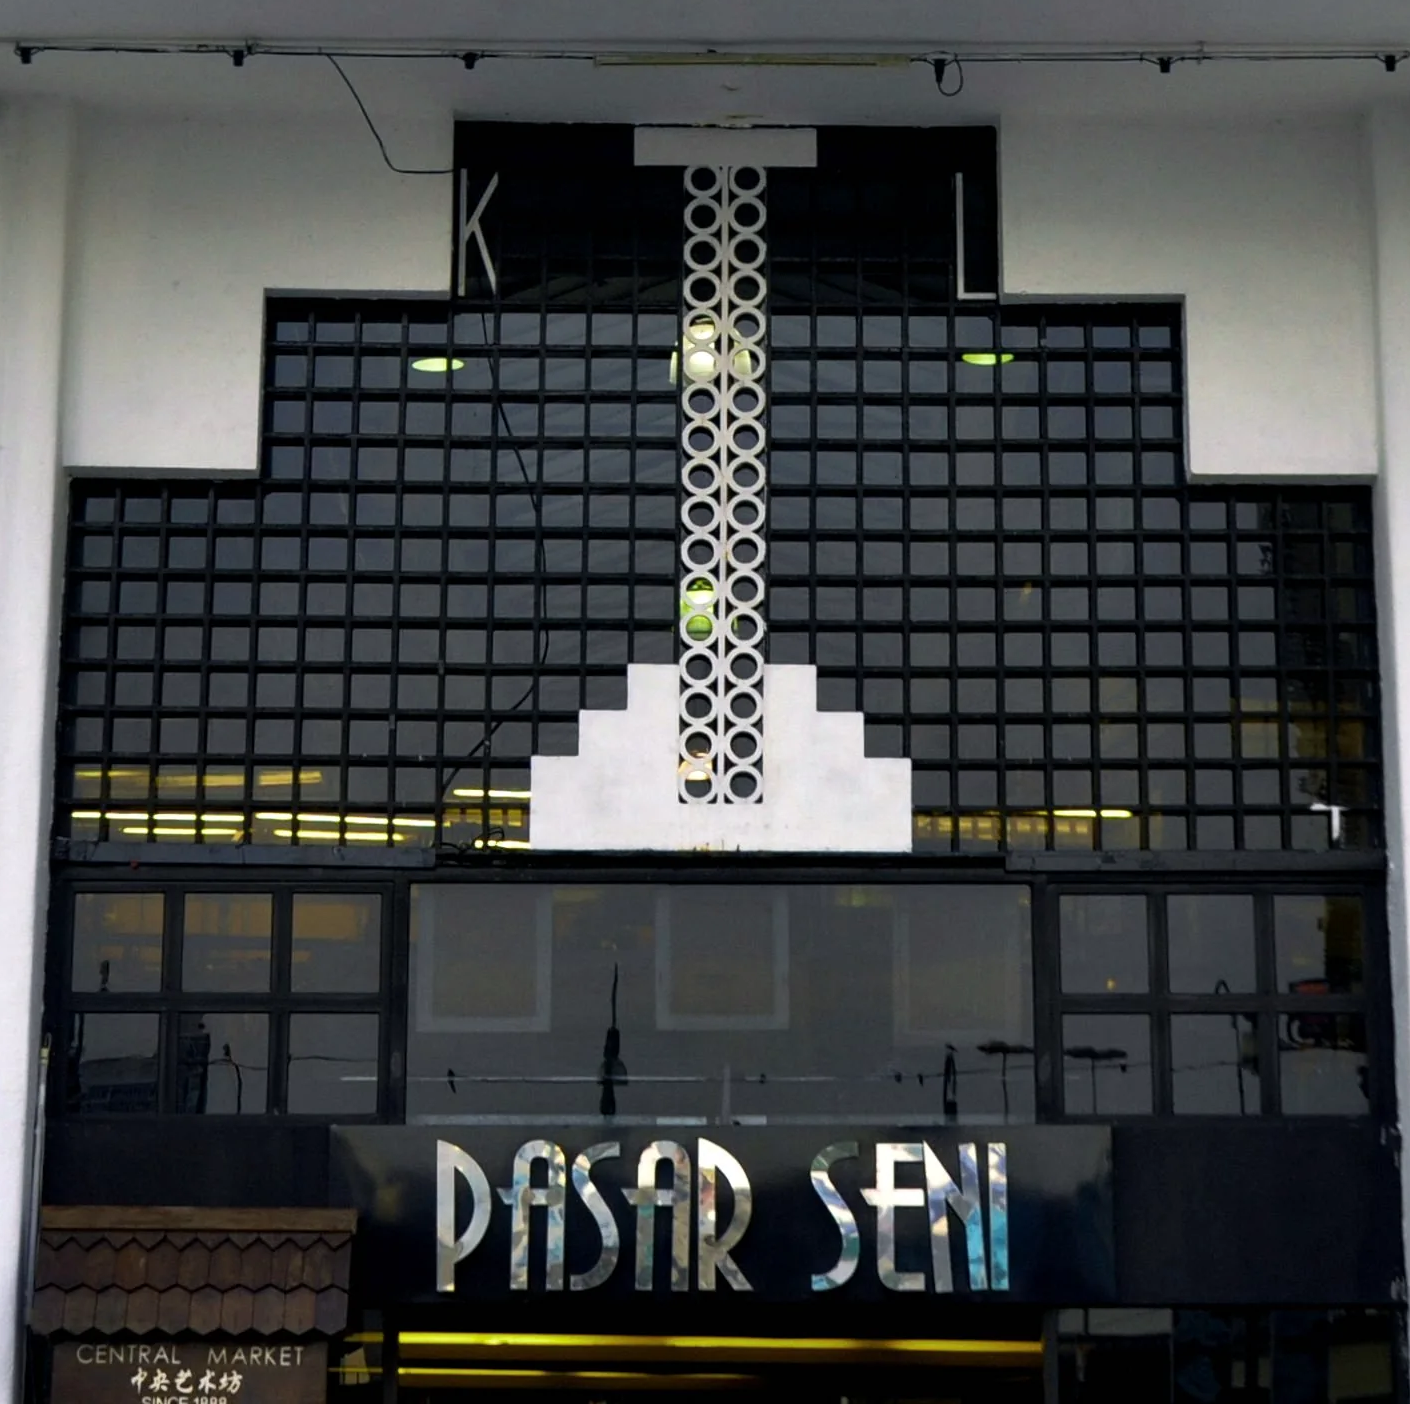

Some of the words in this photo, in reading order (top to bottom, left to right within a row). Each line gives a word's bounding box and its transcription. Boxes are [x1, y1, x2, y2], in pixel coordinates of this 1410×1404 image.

[435, 1137, 753, 1293] PASAR
[809, 1140, 1010, 1294] SENI
[76, 1344, 181, 1365] CENTRAL
[207, 1345, 304, 1366] MARKET
[130, 1366, 243, 1394] 中央艺术坊
